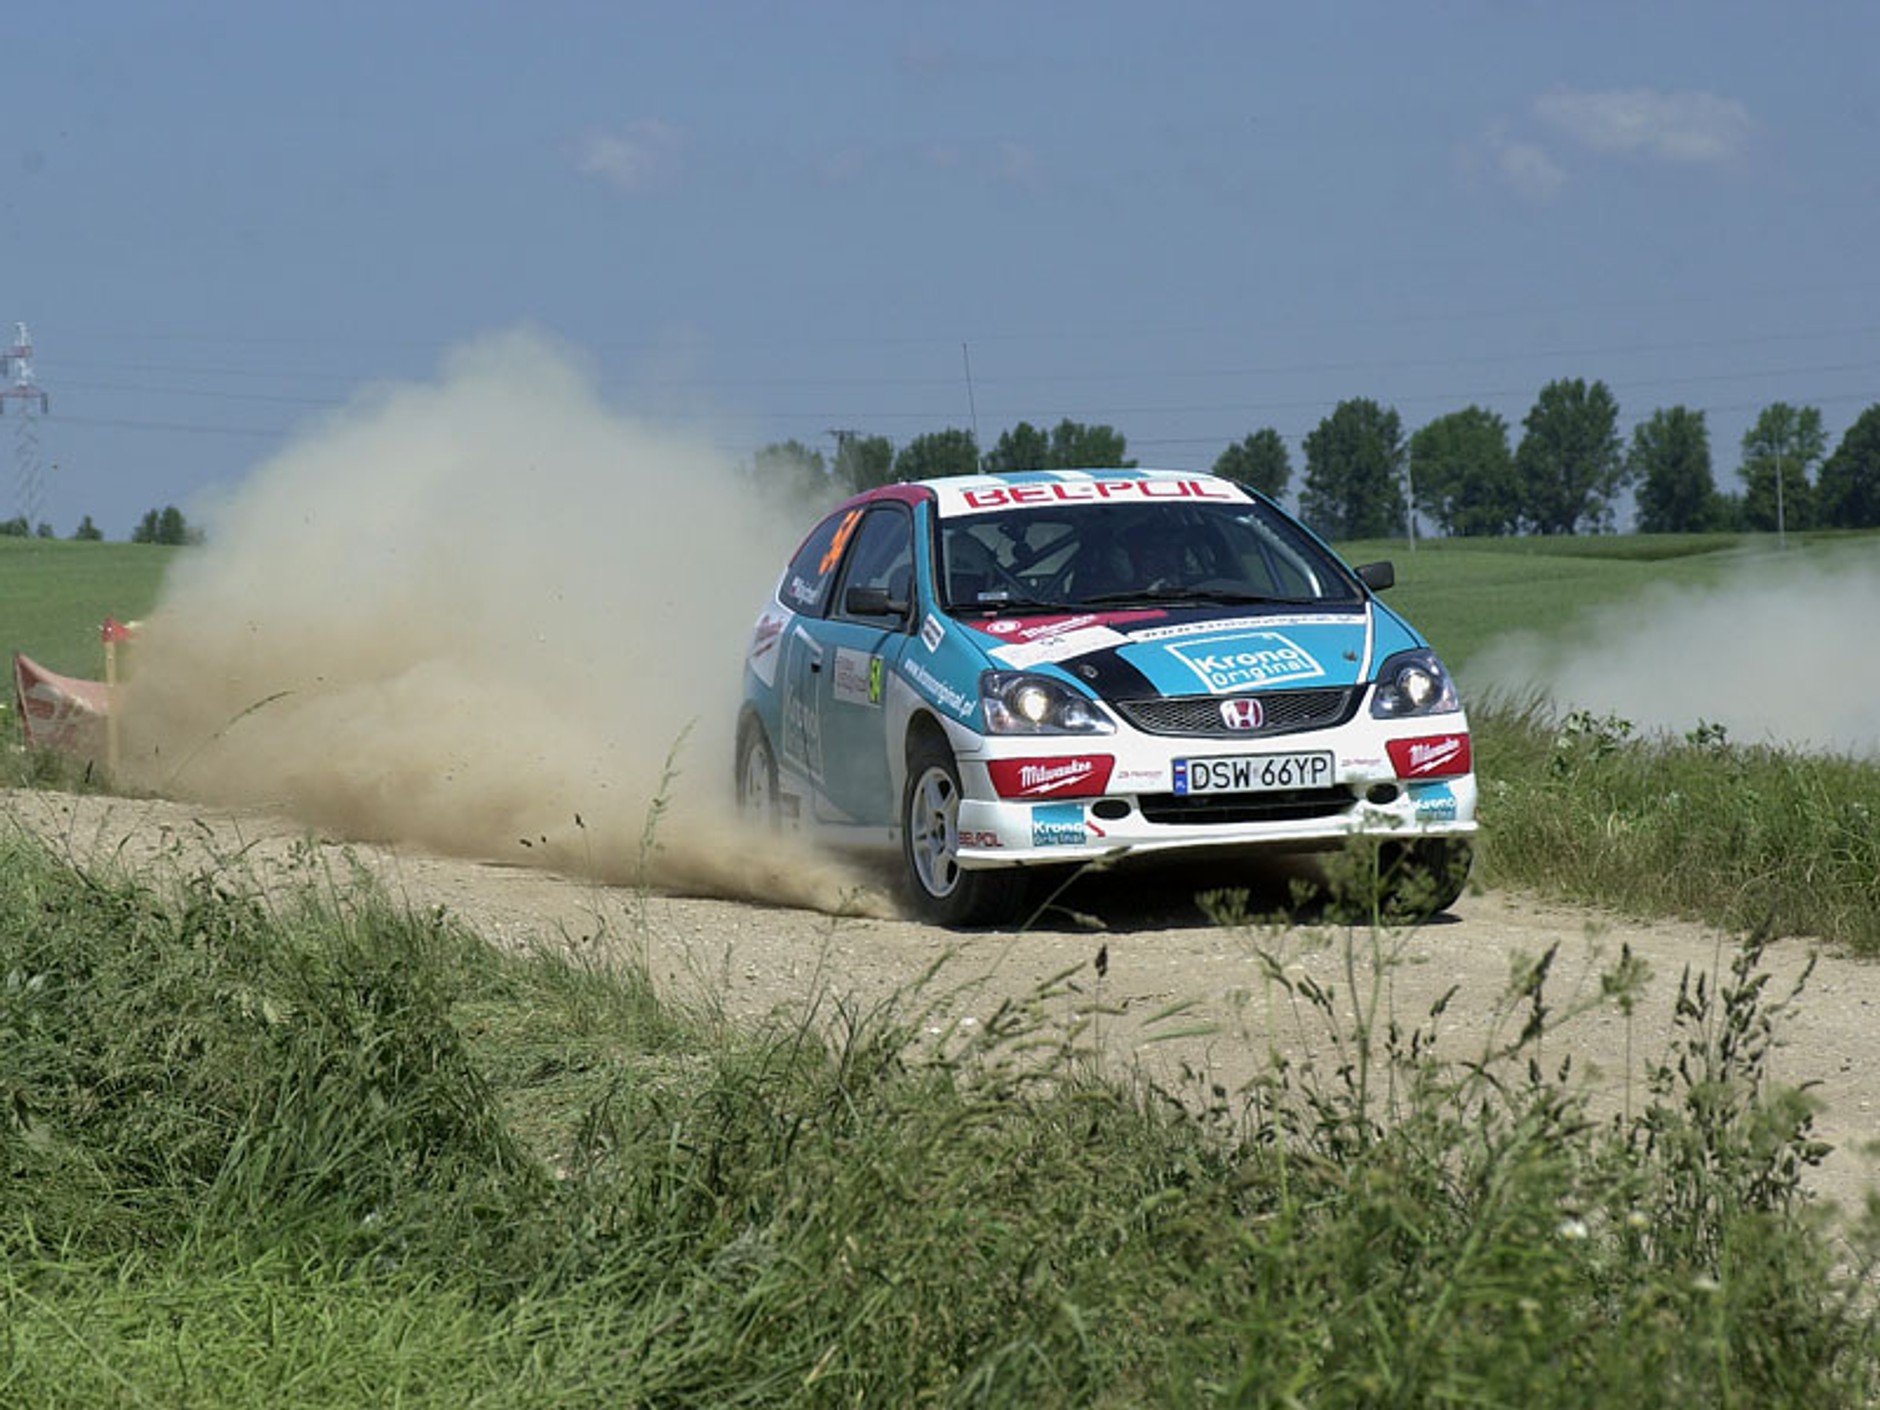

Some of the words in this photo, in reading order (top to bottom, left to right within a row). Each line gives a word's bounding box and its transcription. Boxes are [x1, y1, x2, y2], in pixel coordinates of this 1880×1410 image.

[1194, 649, 1298, 673] Krono
[1212, 658, 1312, 686] Original
[1018, 760, 1092, 788] Milwaukee
[1191, 761, 1251, 791] DSW
[1261, 757, 1328, 787] 66YP
